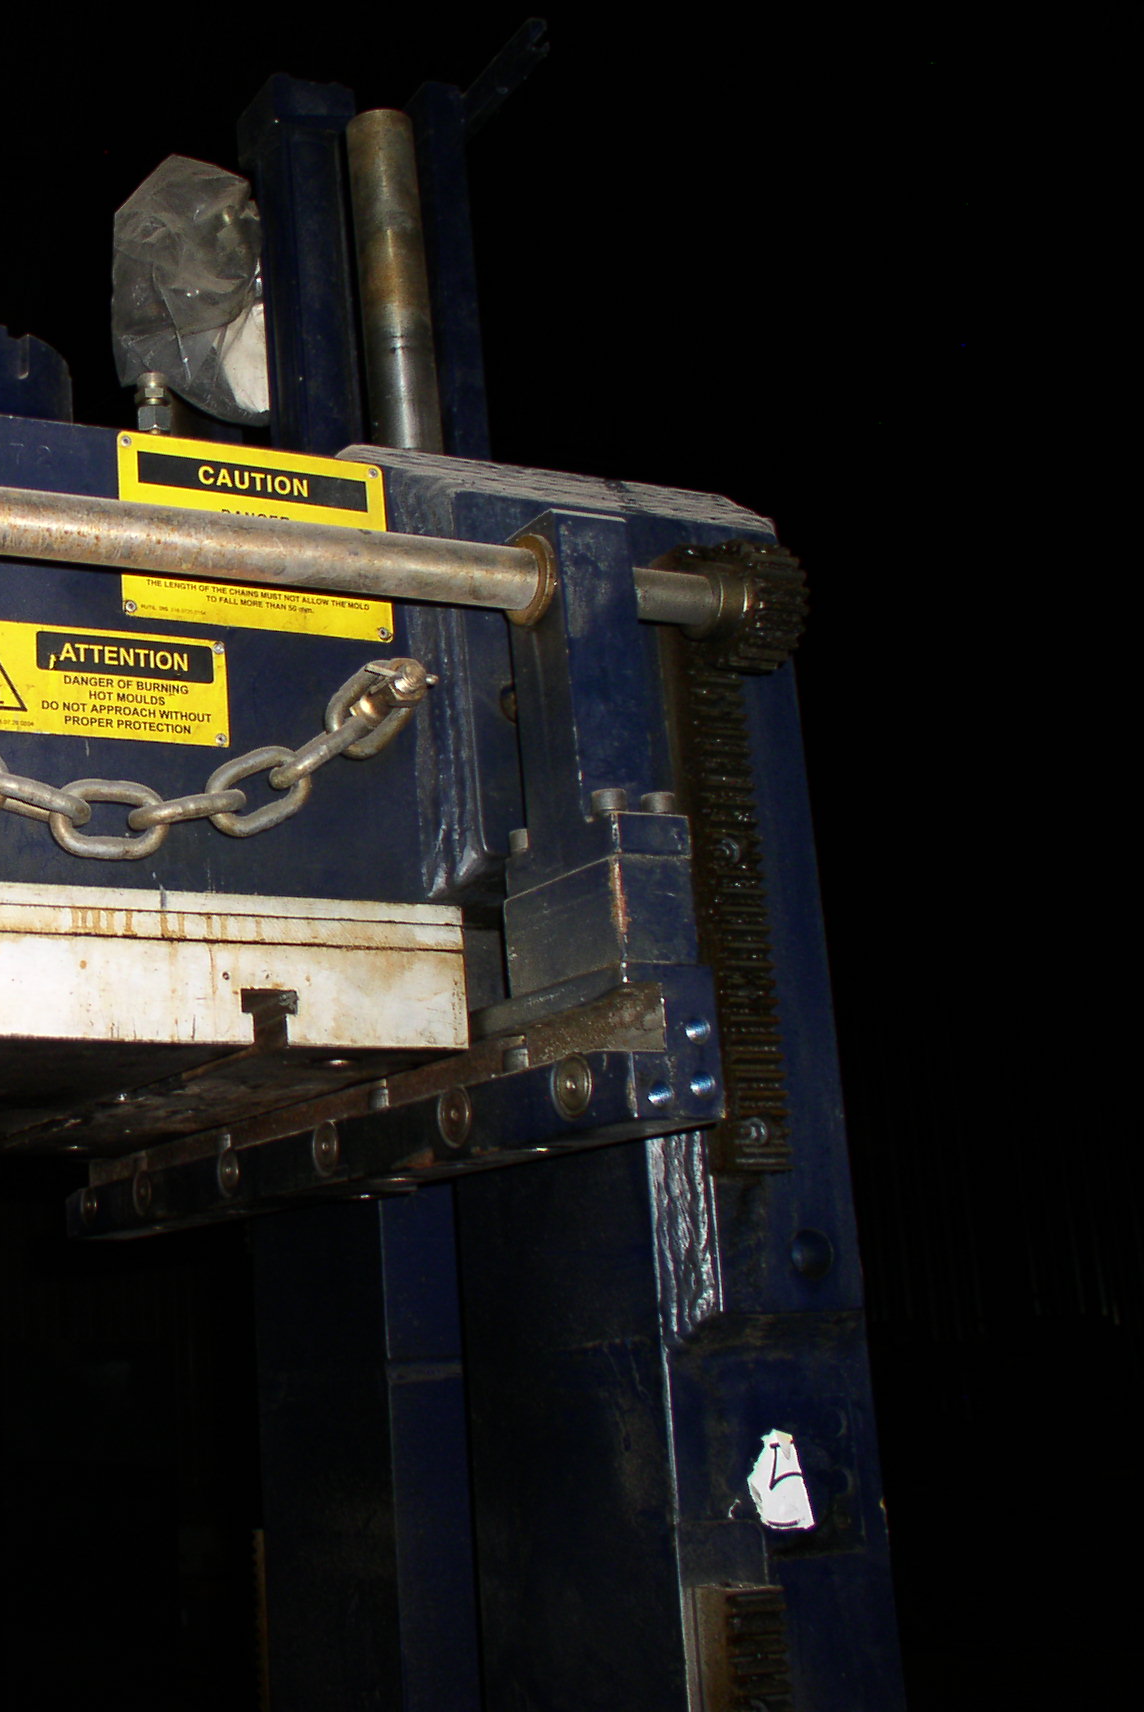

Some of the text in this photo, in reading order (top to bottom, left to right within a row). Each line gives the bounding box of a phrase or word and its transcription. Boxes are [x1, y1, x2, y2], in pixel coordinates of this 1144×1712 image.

[198, 465, 309, 498] CAUTION
[146, 579, 162, 587] THE
[164, 581, 197, 590] LENGTH
[211, 586, 227, 594] THE
[229, 588, 259, 598] CHAINS
[261, 592, 282, 600] MUST
[284, 594, 300, 602] NOT
[302, 597, 329, 605] ALLOW
[331, 600, 346, 608] THE
[348, 602, 370, 610] MOLD
[219, 597, 238, 605] FALL
[240, 599, 263, 607] MORE
[266, 602, 287, 610] THAN
[59, 642, 189, 672] ATTENTION
[63, 675, 189, 694] DANGER OF BURNING
[89, 690, 166, 706] HOT MOULDS
[41, 700, 211, 723] DO NOT APPROACH WITHOUT
[64, 715, 191, 734] PROPER PROTECTION
